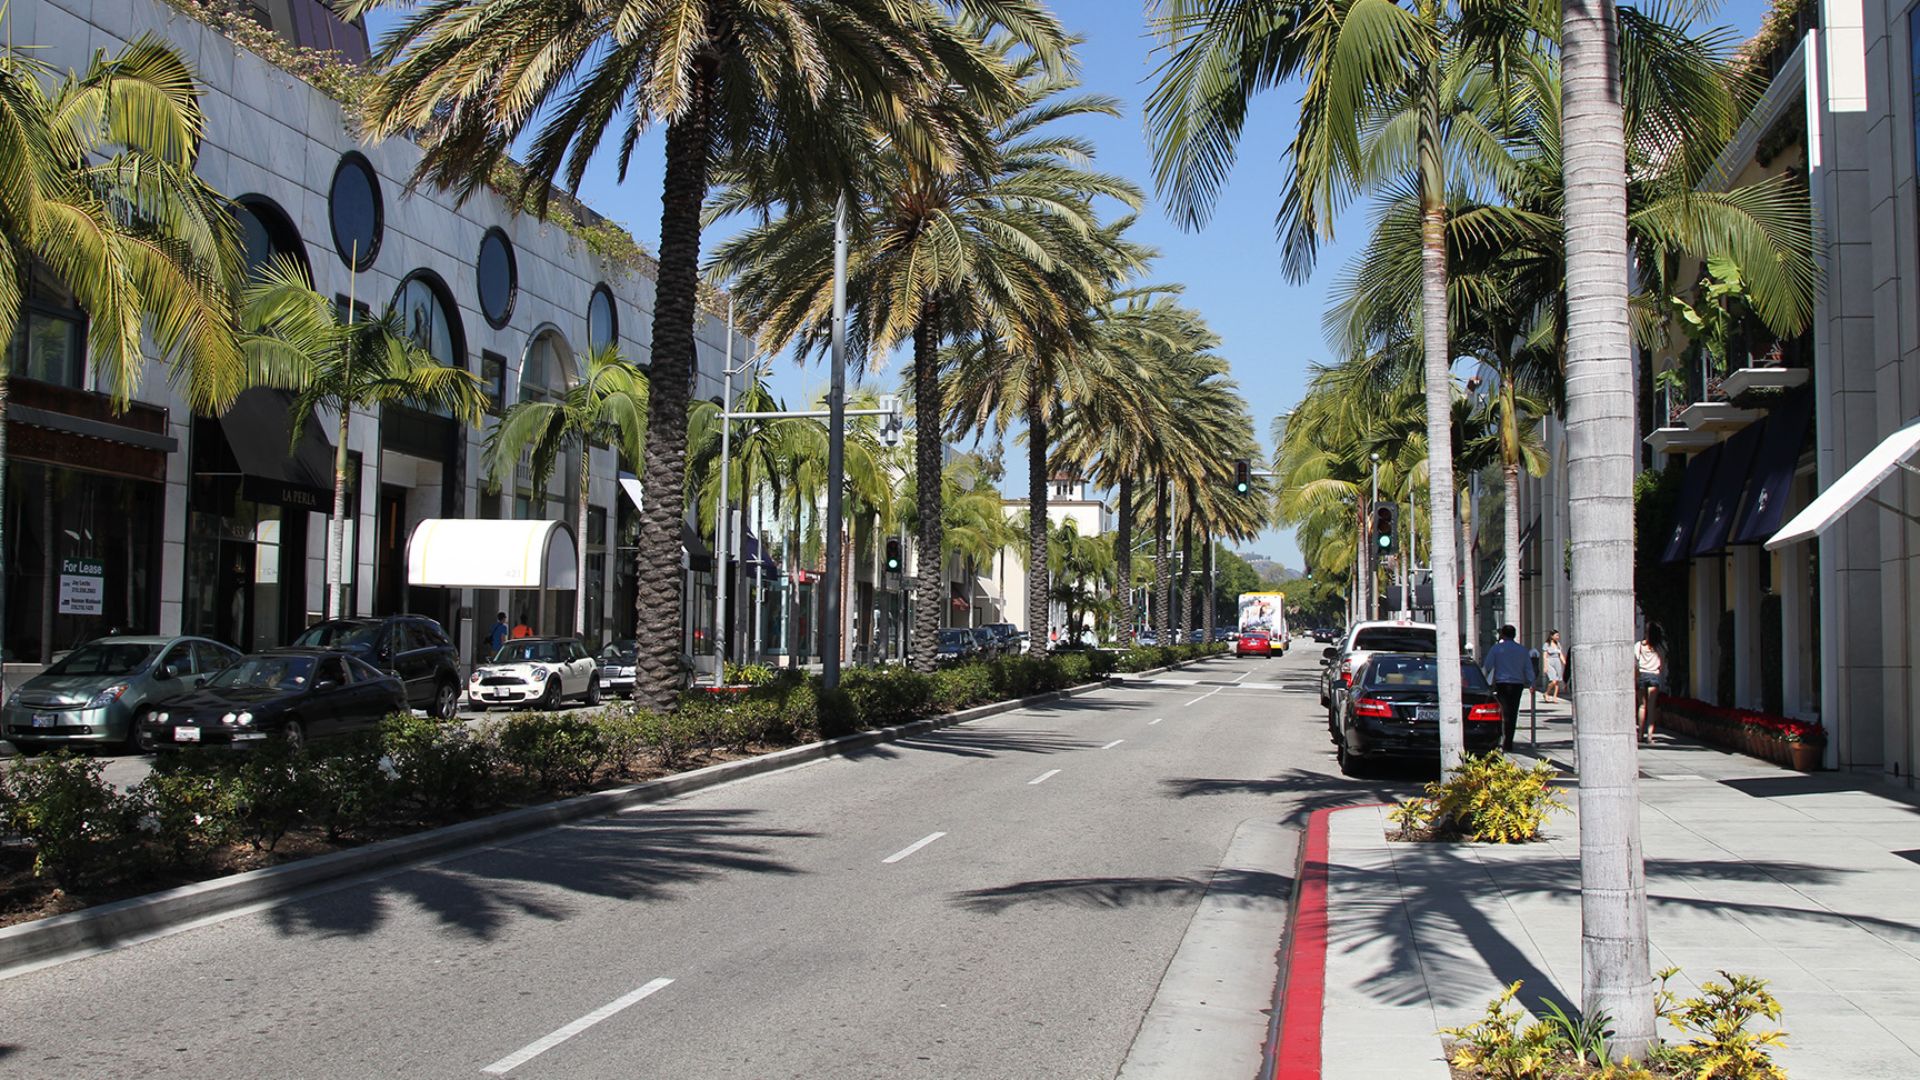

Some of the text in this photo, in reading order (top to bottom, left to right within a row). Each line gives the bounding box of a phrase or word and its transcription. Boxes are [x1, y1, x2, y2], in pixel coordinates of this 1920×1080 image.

[282, 489, 316, 505] LA PERLA
[63, 560, 102, 574] For Lease
